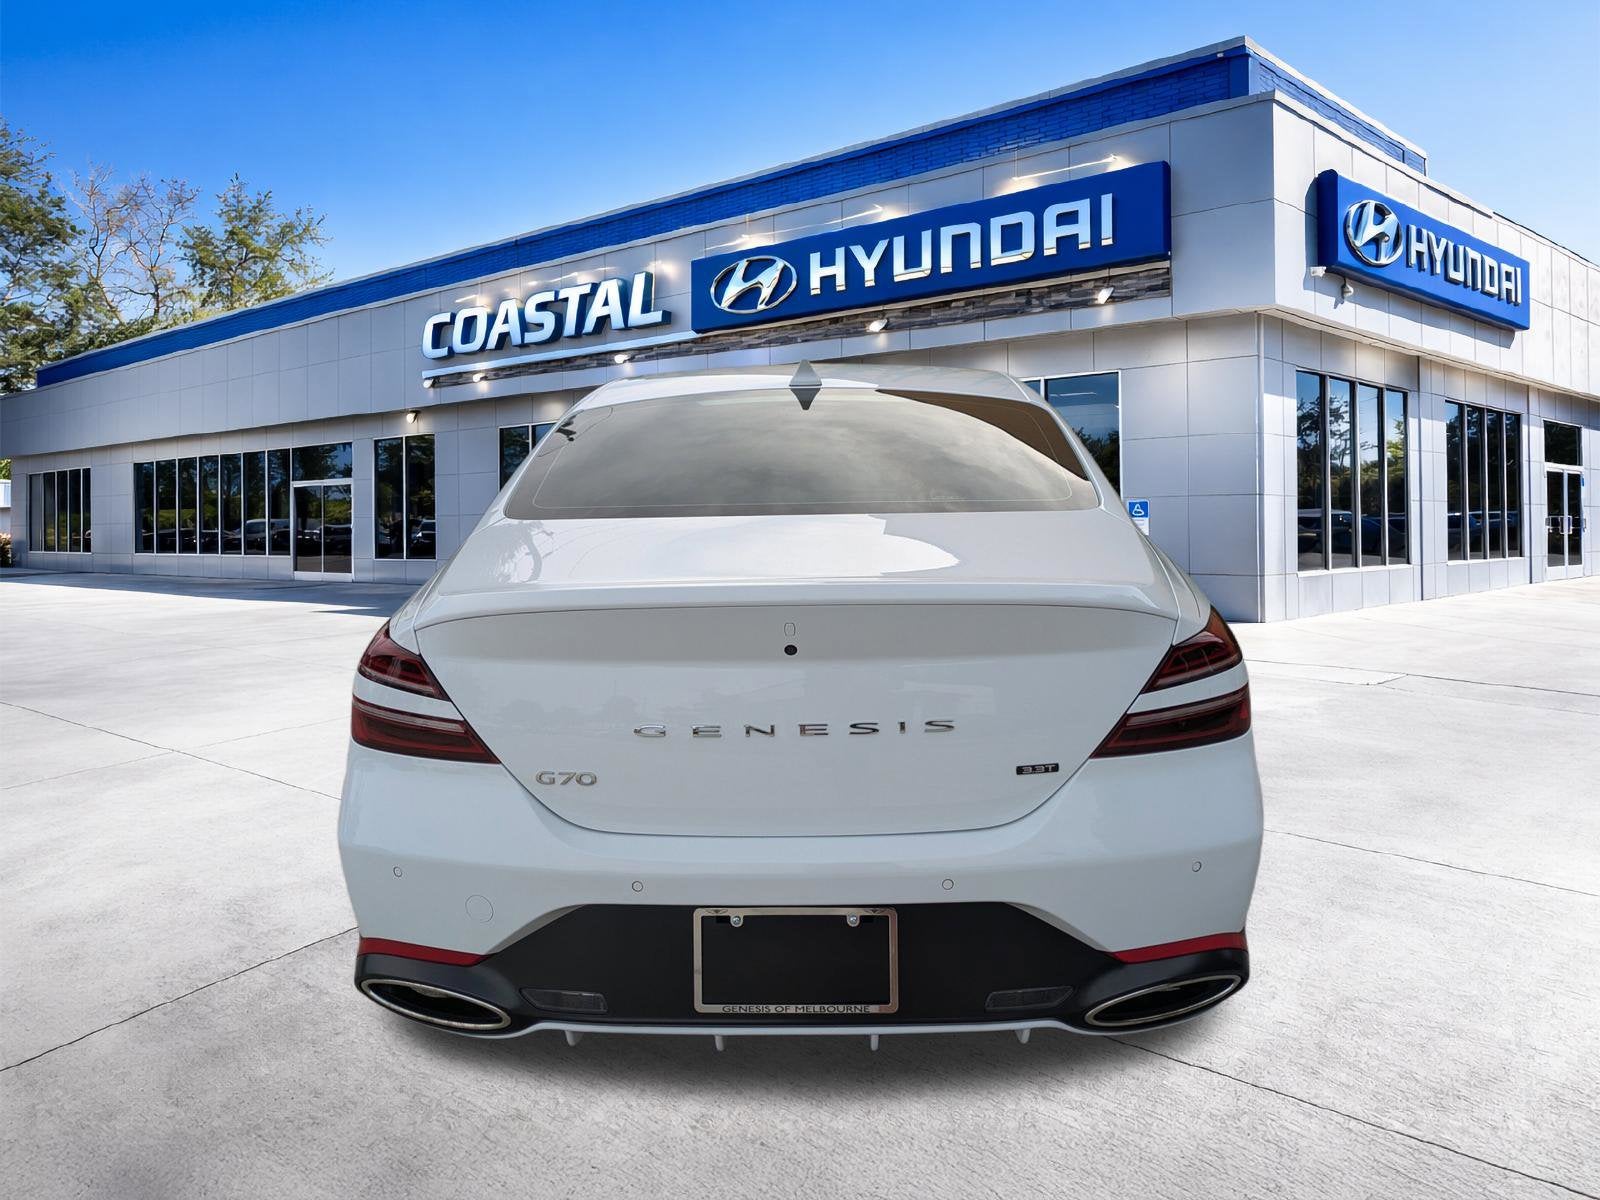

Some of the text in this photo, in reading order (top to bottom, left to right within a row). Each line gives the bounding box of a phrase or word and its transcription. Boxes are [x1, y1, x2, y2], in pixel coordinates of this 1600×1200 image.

[809, 194, 1113, 295] HYUNDAI
[1407, 225, 1522, 305] HYUNDAI
[421, 272, 667, 359] COASTAL
[633, 720, 955, 738] GENESIS
[535, 770, 599, 787] G70
[722, 1005, 870, 1013] GENESIS OF MELBOURNE
